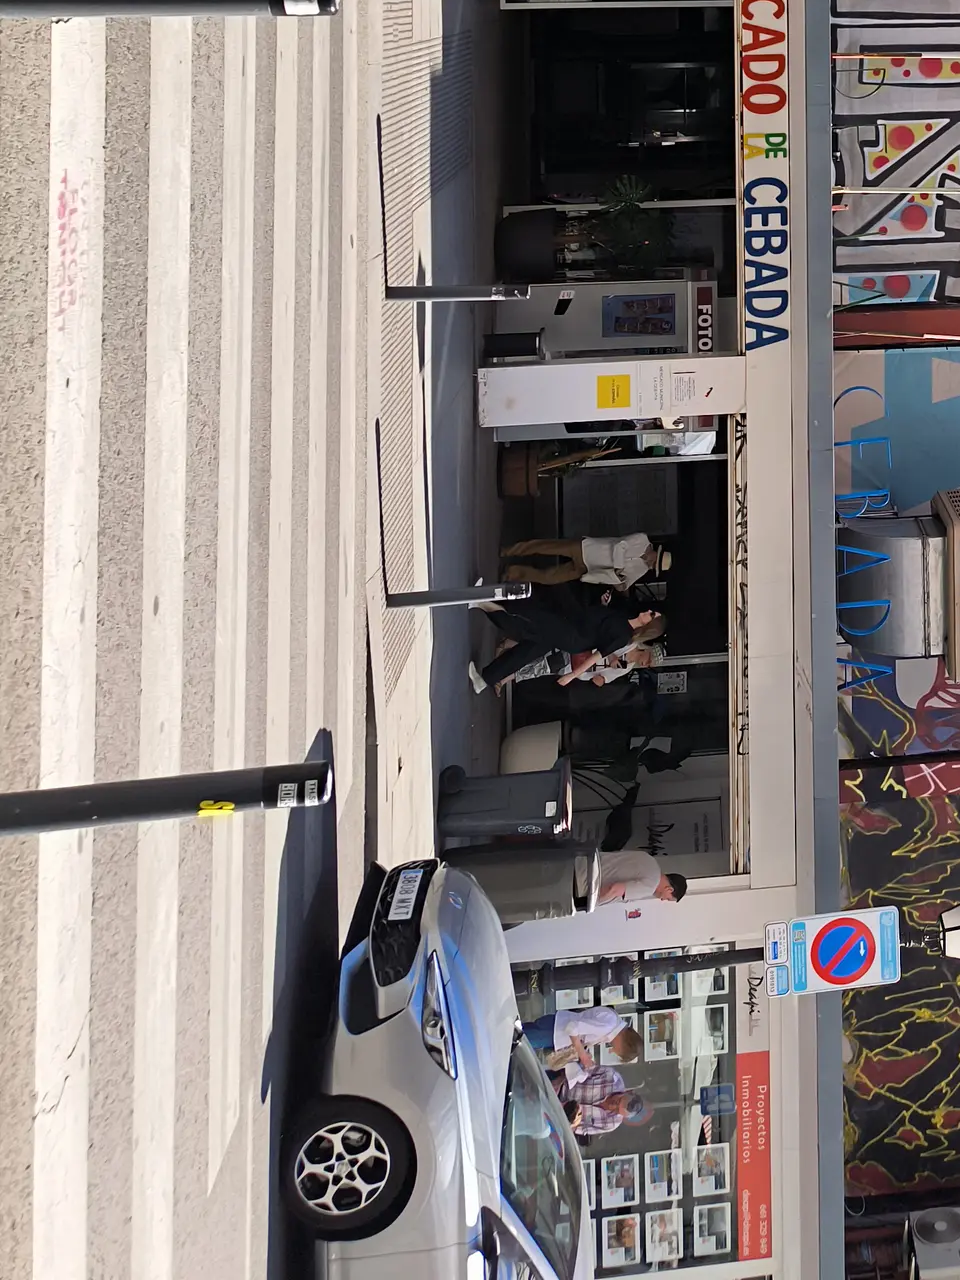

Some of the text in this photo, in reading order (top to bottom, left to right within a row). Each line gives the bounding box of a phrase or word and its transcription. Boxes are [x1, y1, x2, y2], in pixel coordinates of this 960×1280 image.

[743, 133, 765, 160] LA
[765, 133, 787, 159] DE
[743, 177, 789, 351] CEBADA
[698, 304, 712, 355] FOTO
[393, 874, 418, 916] 3808 MXT
[743, 976, 764, 1018] Deapi
[741, 1075, 753, 1164] Inmobiliarios
[755, 1084, 768, 1151] Proyectos
